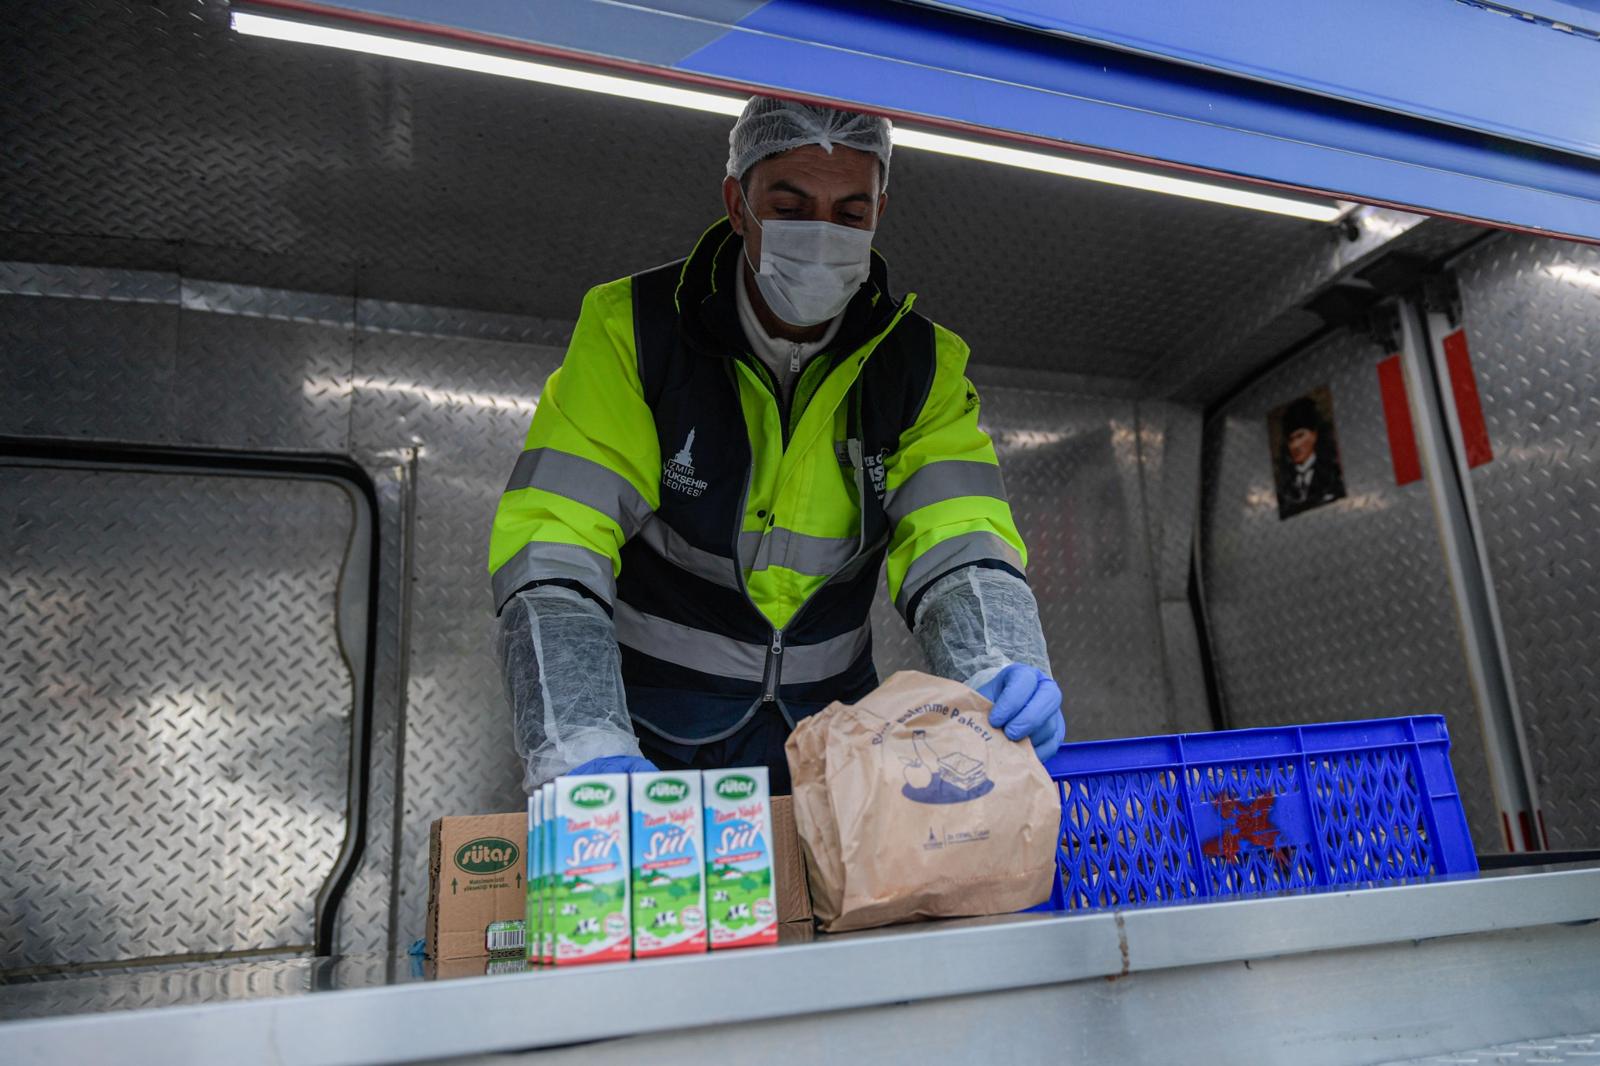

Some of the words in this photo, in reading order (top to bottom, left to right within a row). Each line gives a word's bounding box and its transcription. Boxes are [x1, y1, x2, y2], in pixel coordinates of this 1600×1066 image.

[662, 477, 702, 496] LEDİYESİ
[664, 468, 708, 490] YÜKŞEHİR
[950, 708, 993, 742] Paketi
[567, 831, 619, 866] Süt
[645, 826, 695, 859] Süt
[716, 822, 764, 854] Süt
[462, 845, 512, 865] sütaş
